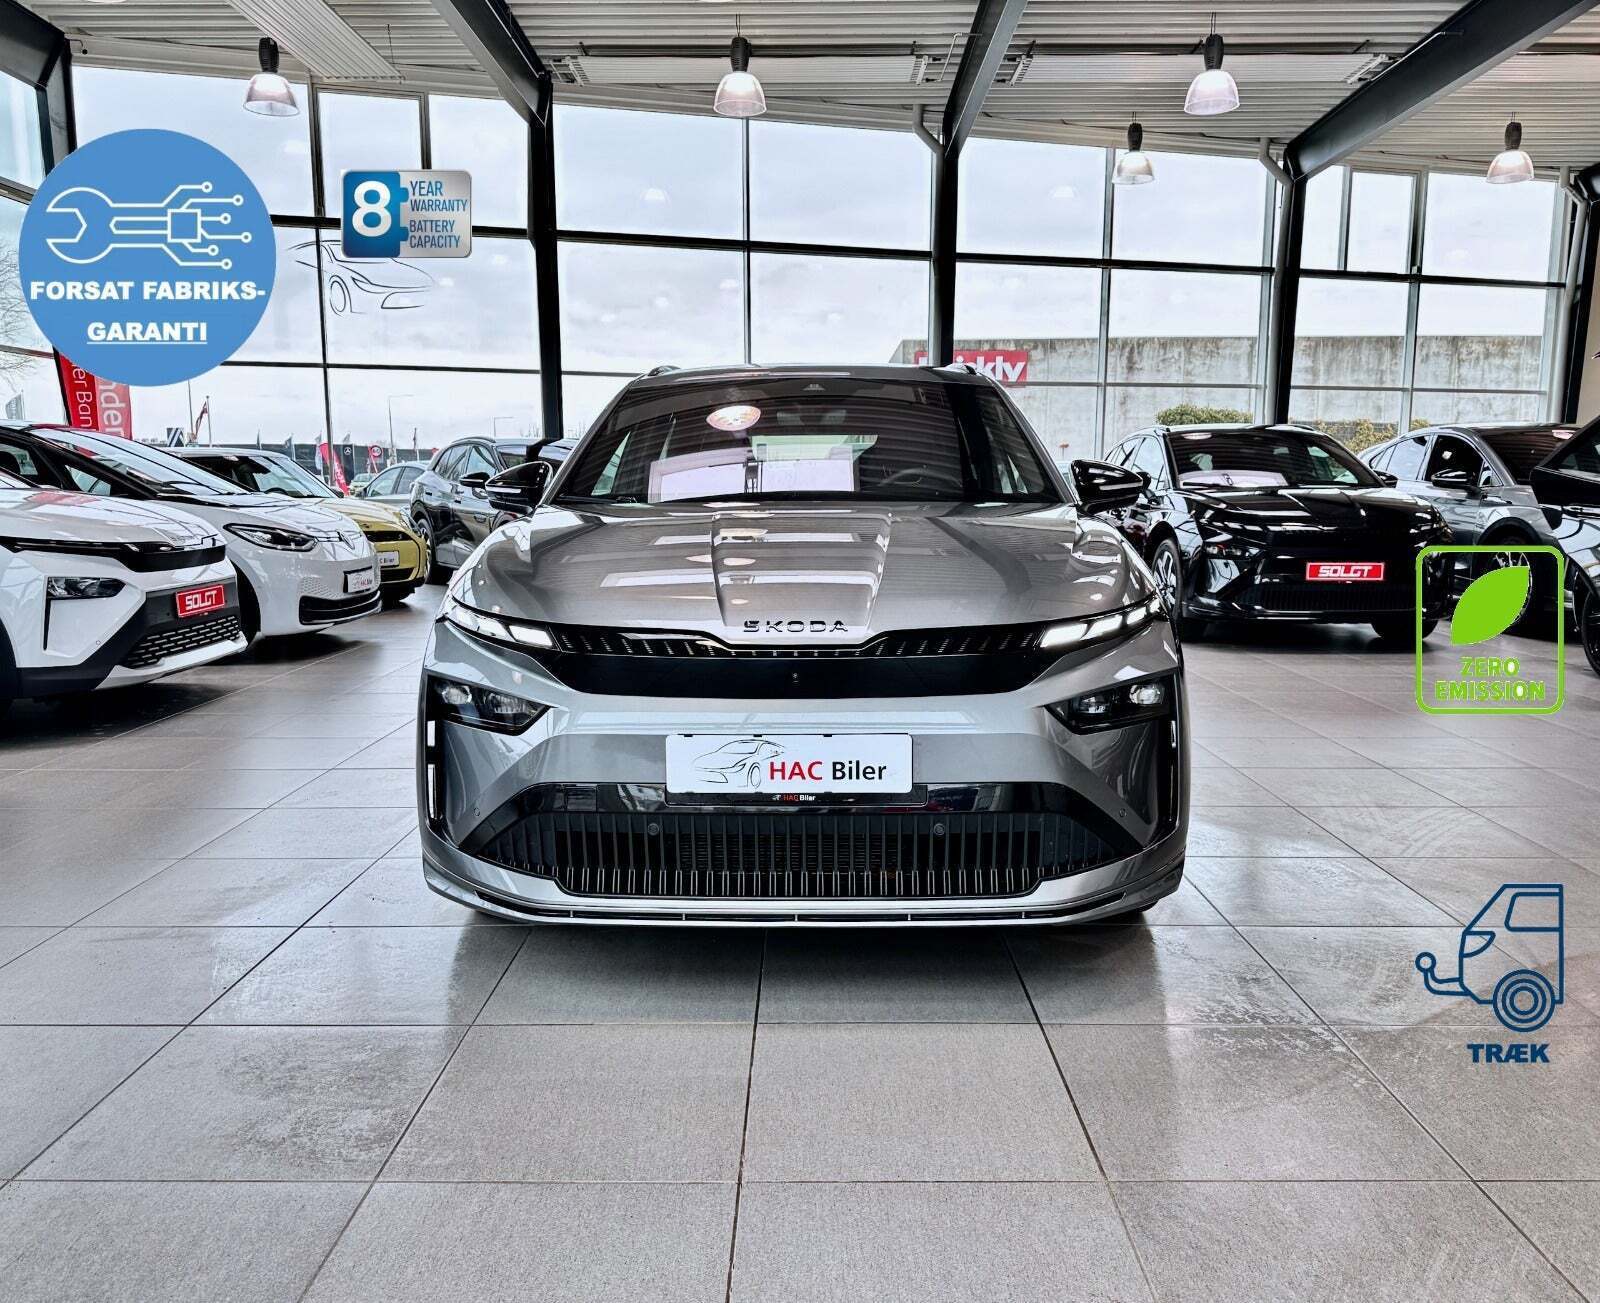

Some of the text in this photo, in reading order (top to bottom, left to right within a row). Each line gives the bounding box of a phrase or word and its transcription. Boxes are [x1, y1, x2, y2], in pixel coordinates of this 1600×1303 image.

[72, 365, 97, 431] er Ban
[1317, 565, 1373, 578] SOLGT
[185, 590, 218, 611] SOLGT
[769, 760, 887, 781] HAC Biler
